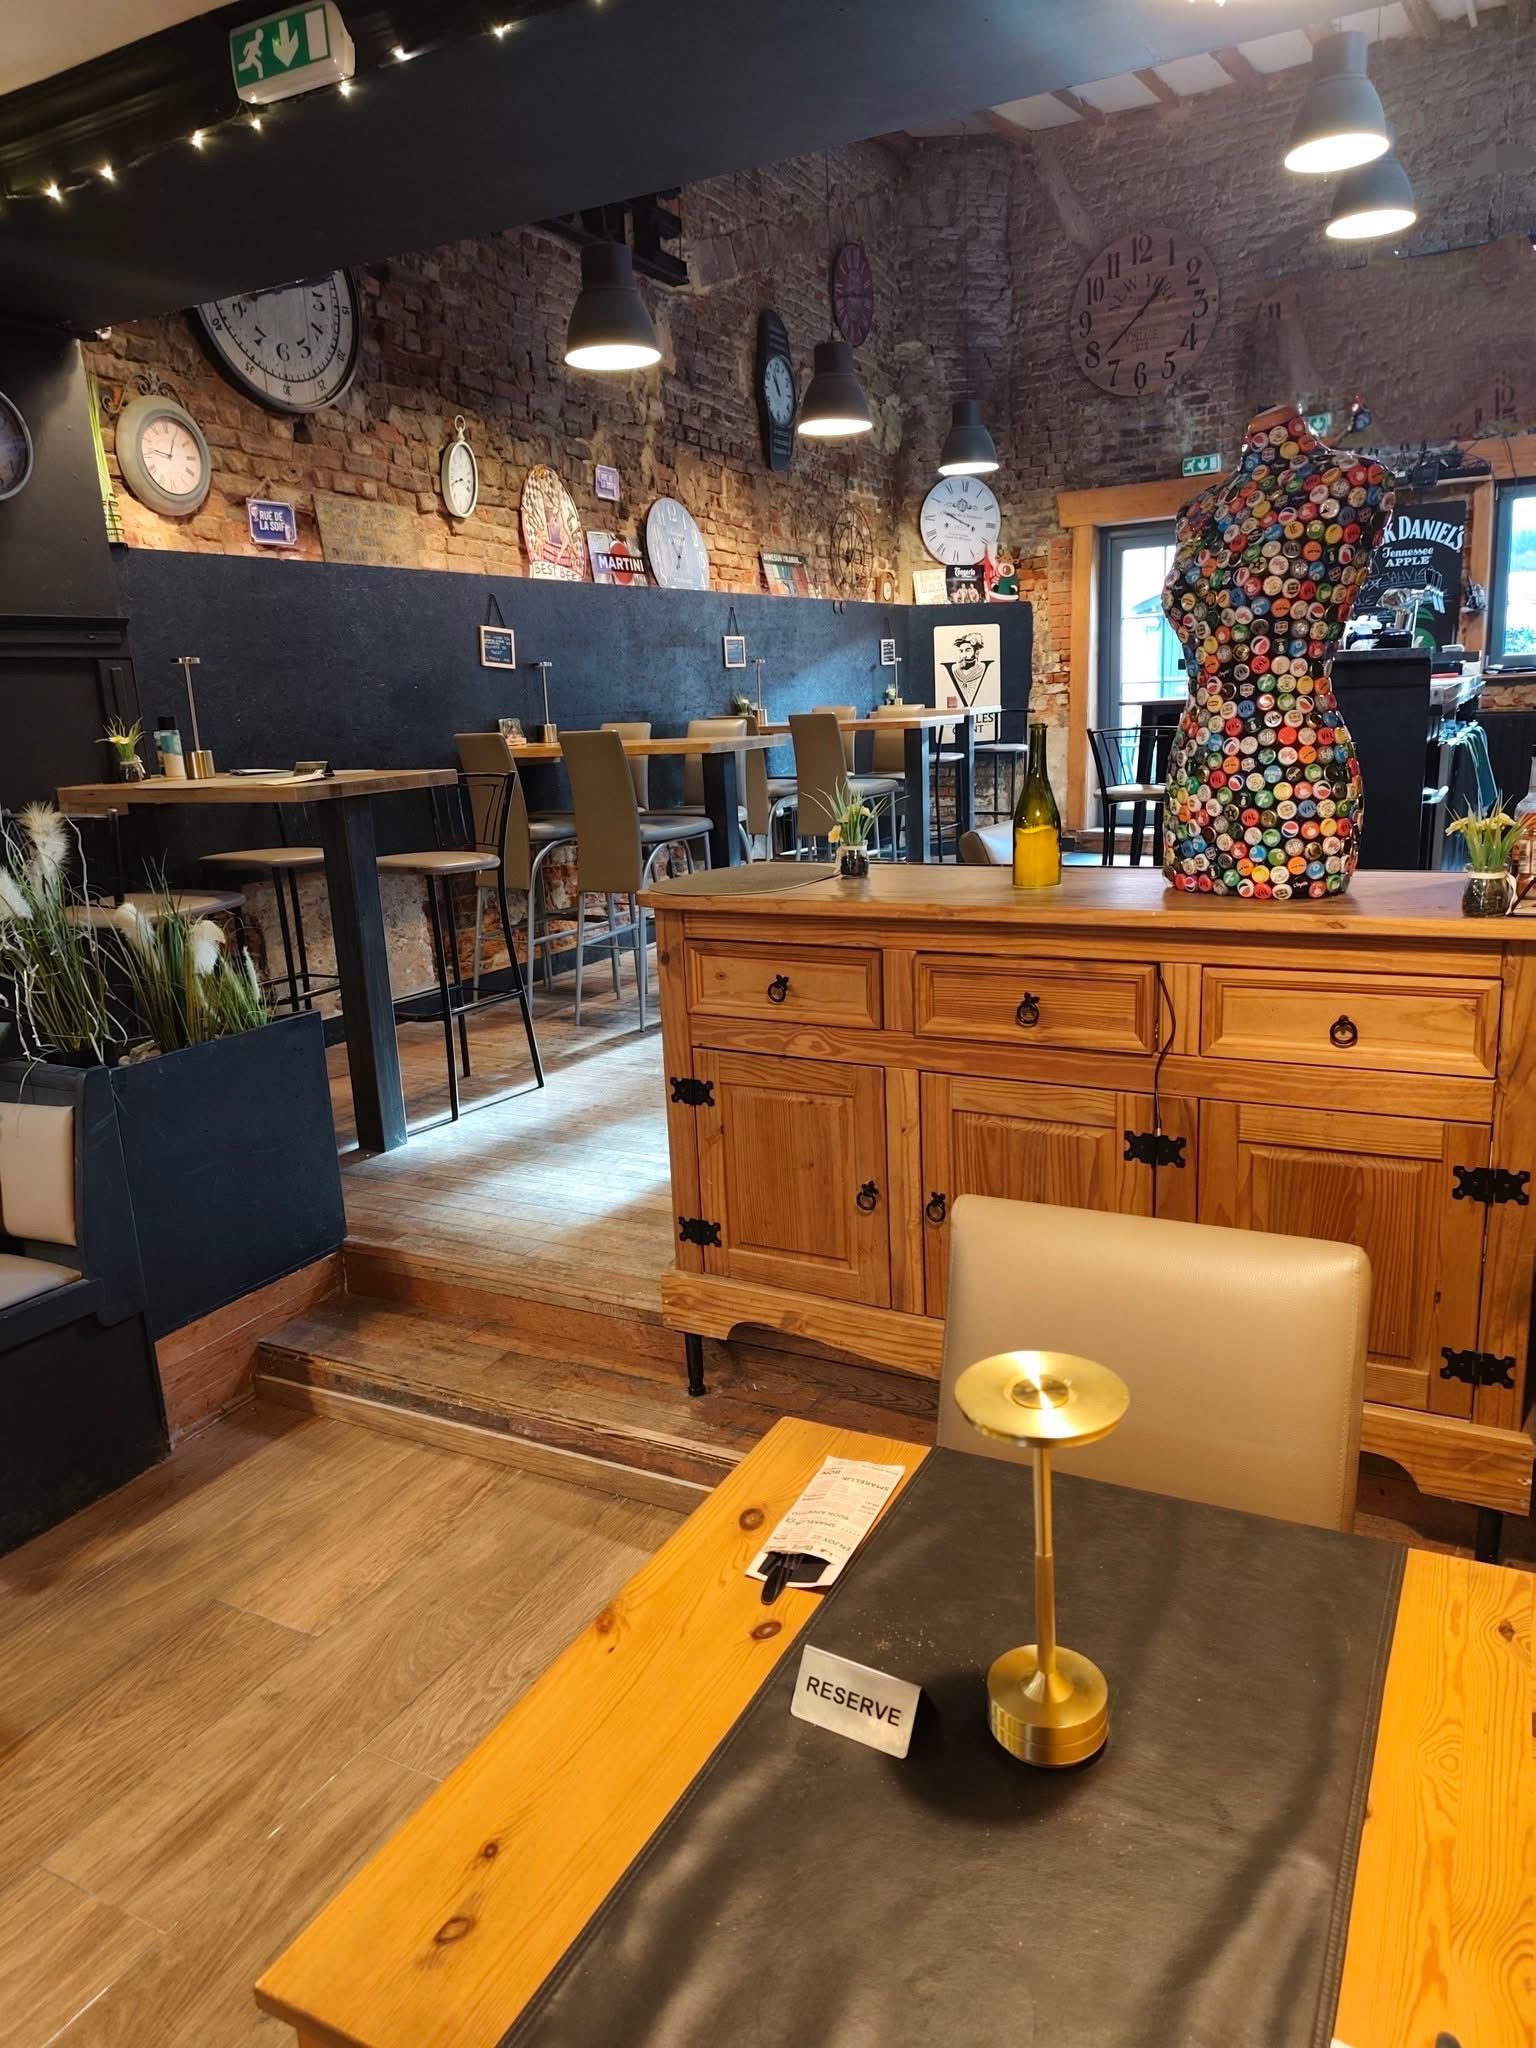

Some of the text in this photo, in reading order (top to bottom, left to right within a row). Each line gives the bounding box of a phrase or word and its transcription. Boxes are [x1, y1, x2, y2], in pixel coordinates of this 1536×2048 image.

[1131, 233, 1153, 265] 12
[1107, 252, 1120, 280] 11
[1186, 256, 1202, 286] 2
[1086, 276, 1105, 306] 10
[1192, 287, 1209, 319] 3
[1079, 310, 1092, 338] 9
[1179, 322, 1198, 351] 4
[275, 342, 291, 362] 6
[296, 337, 312, 360] 5
[1084, 340, 1100, 369] 8
[1107, 358, 1121, 388] 7
[1133, 361, 1147, 390] 6
[1161, 350, 1177, 380] 5
[259, 510, 284, 522] RUE DE
[259, 521, 286, 532] LA SOIF
[1398, 515, 1465, 550] DANIEL'S
[598, 554, 645, 573] MARTINI
[1382, 546, 1434, 559] Tennessee
[1385, 555, 1432, 568] APPLE
[534, 563, 557, 576] BEST
[822, 1537, 852, 1552] ENJOY
[806, 1675, 903, 1728] RESERVE
